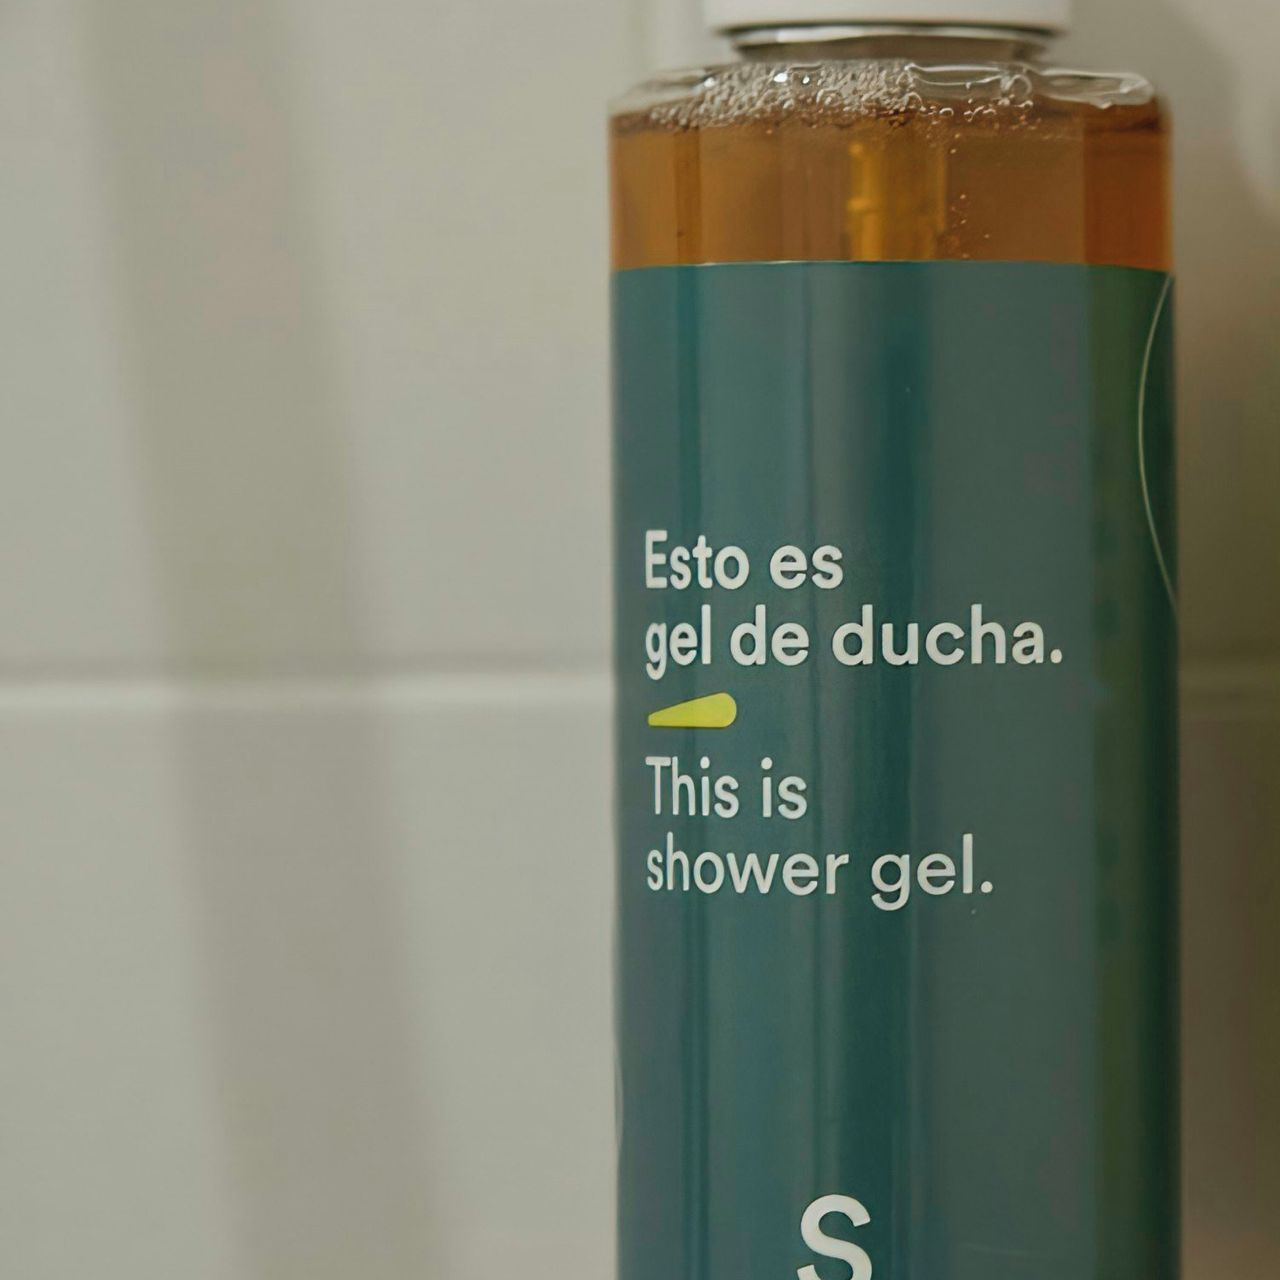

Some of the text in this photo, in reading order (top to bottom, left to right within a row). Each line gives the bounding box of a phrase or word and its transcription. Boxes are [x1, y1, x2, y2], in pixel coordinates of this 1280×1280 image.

[645, 529, 843, 590] Esto es
[645, 603, 1063, 681] gel de ducha.
[645, 756, 807, 820] This is
[647, 831, 993, 911] shower gel.
